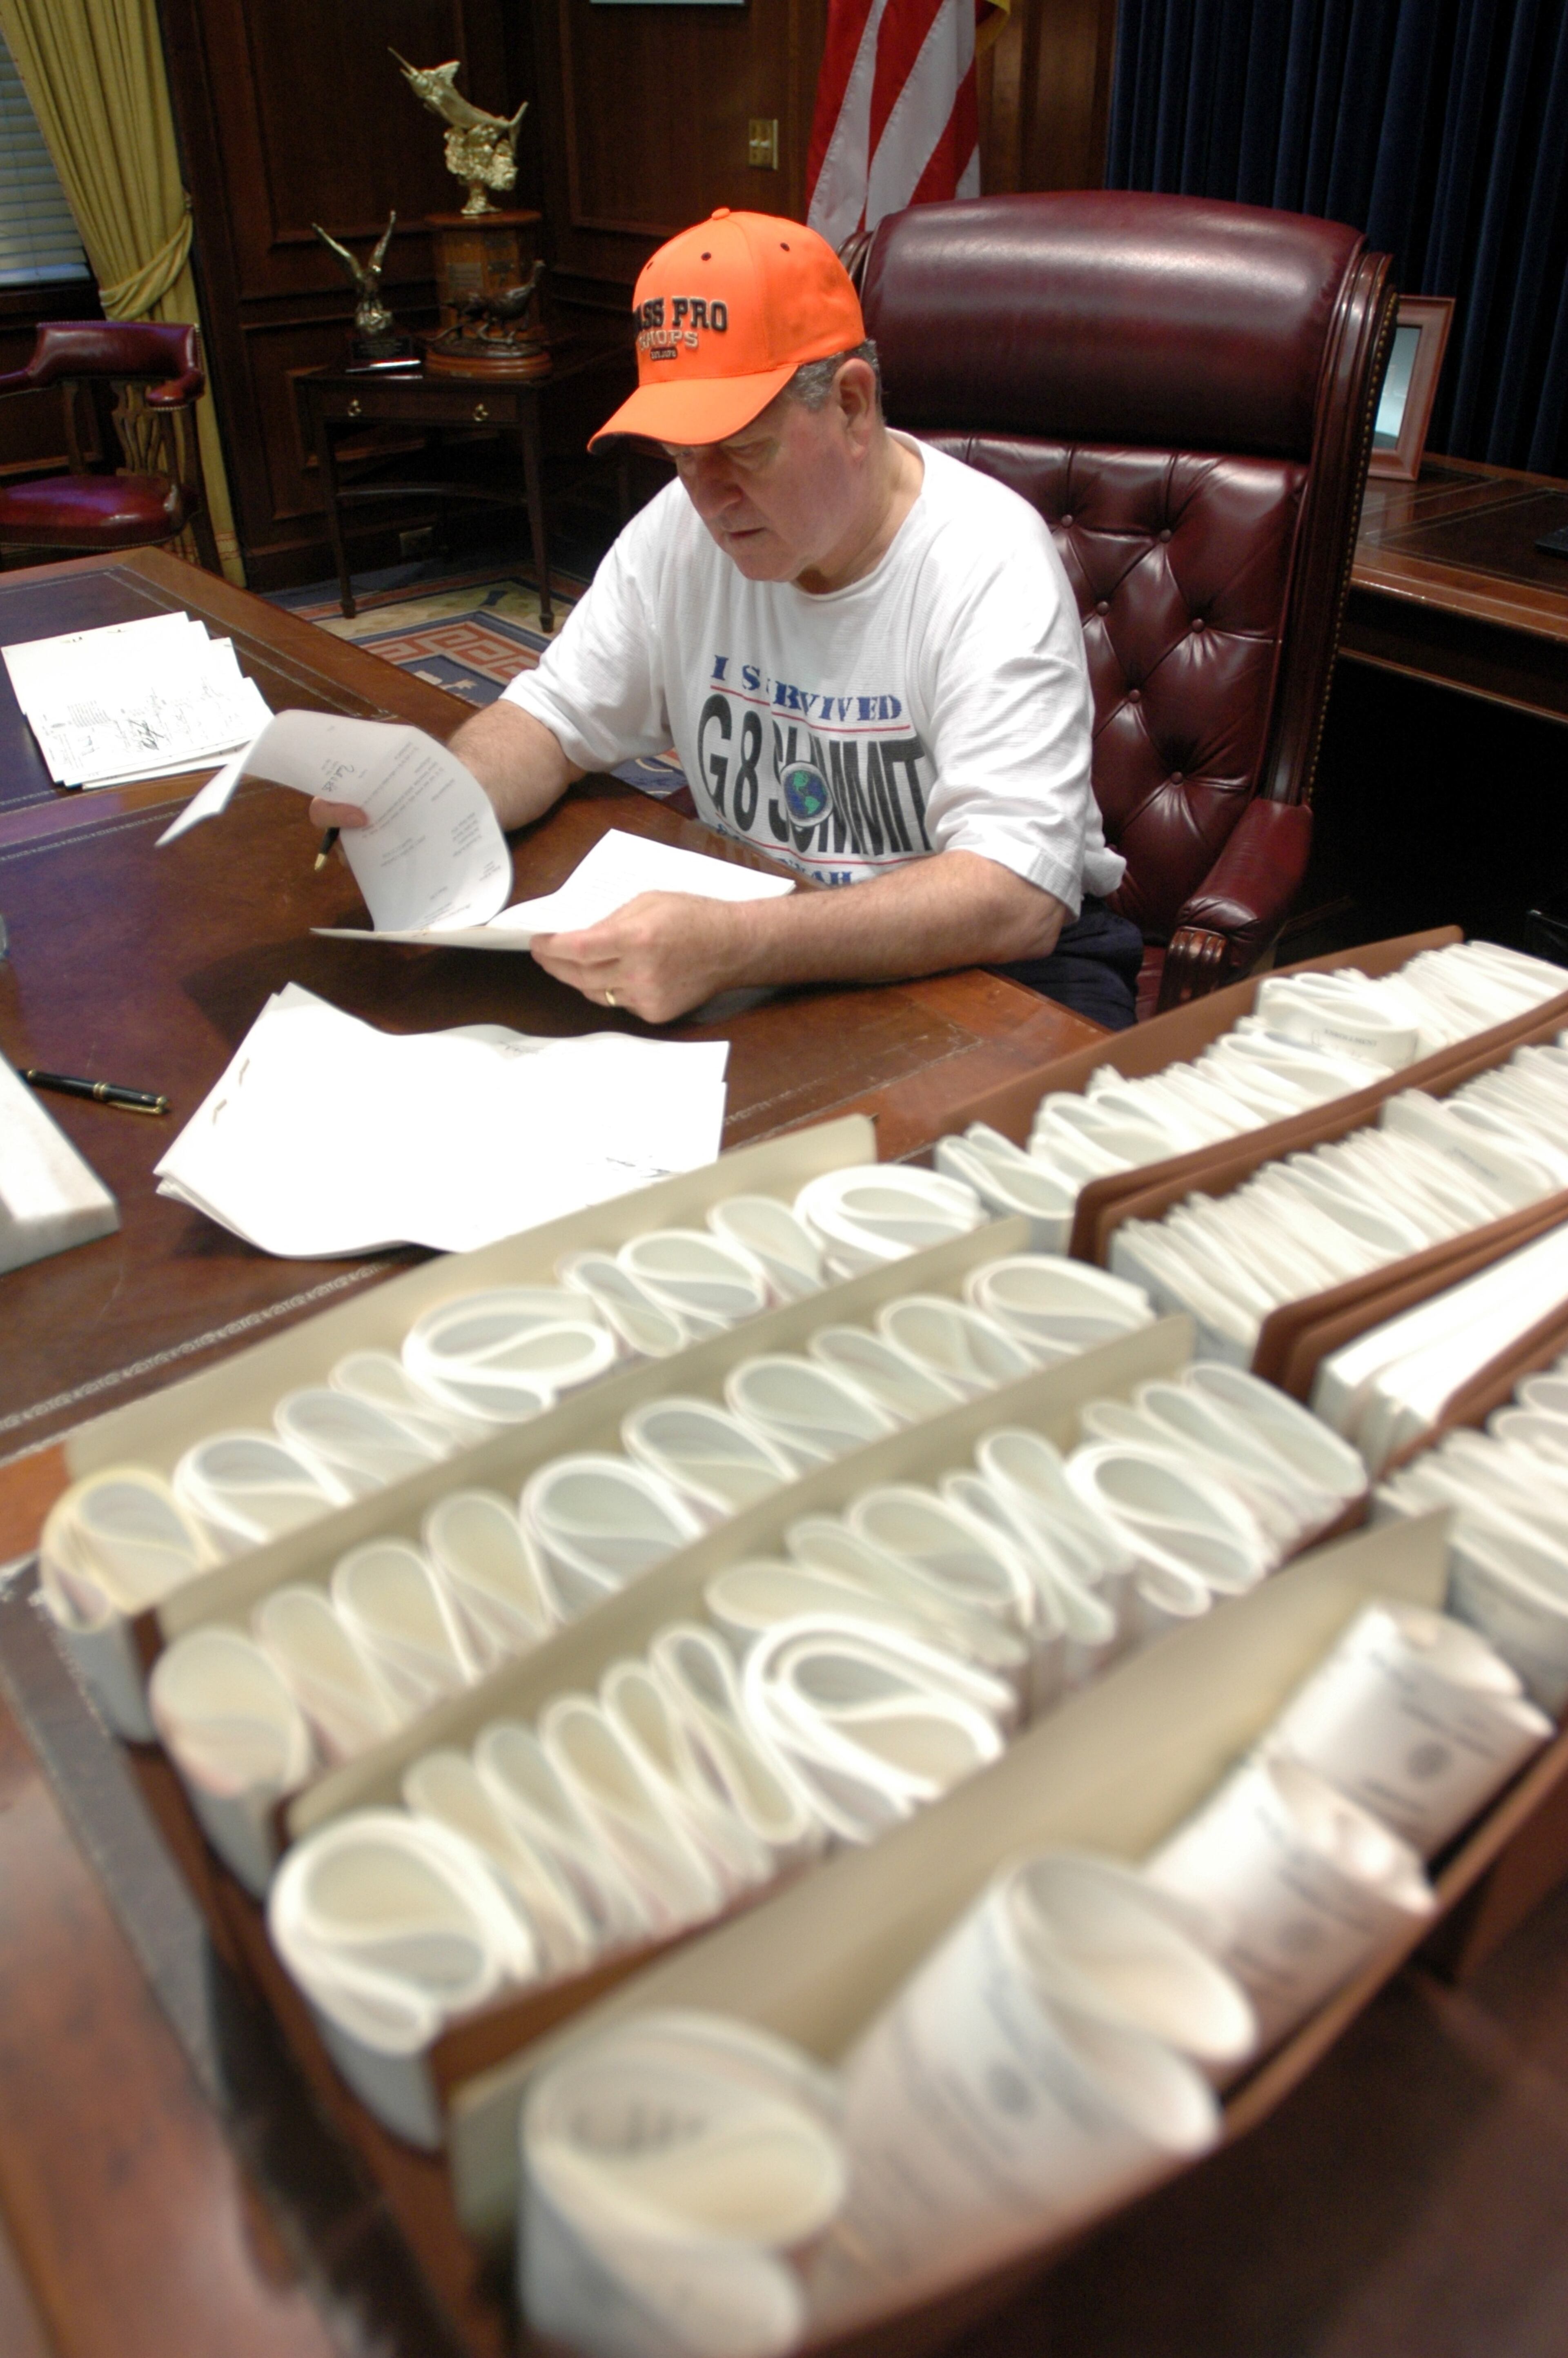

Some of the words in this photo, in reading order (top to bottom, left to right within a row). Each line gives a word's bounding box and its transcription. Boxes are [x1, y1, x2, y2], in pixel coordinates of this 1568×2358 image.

[672, 296, 728, 332] PRO
[710, 655, 729, 681] I
[742, 664, 902, 722] SRVIVED
[697, 693, 763, 831] G8
